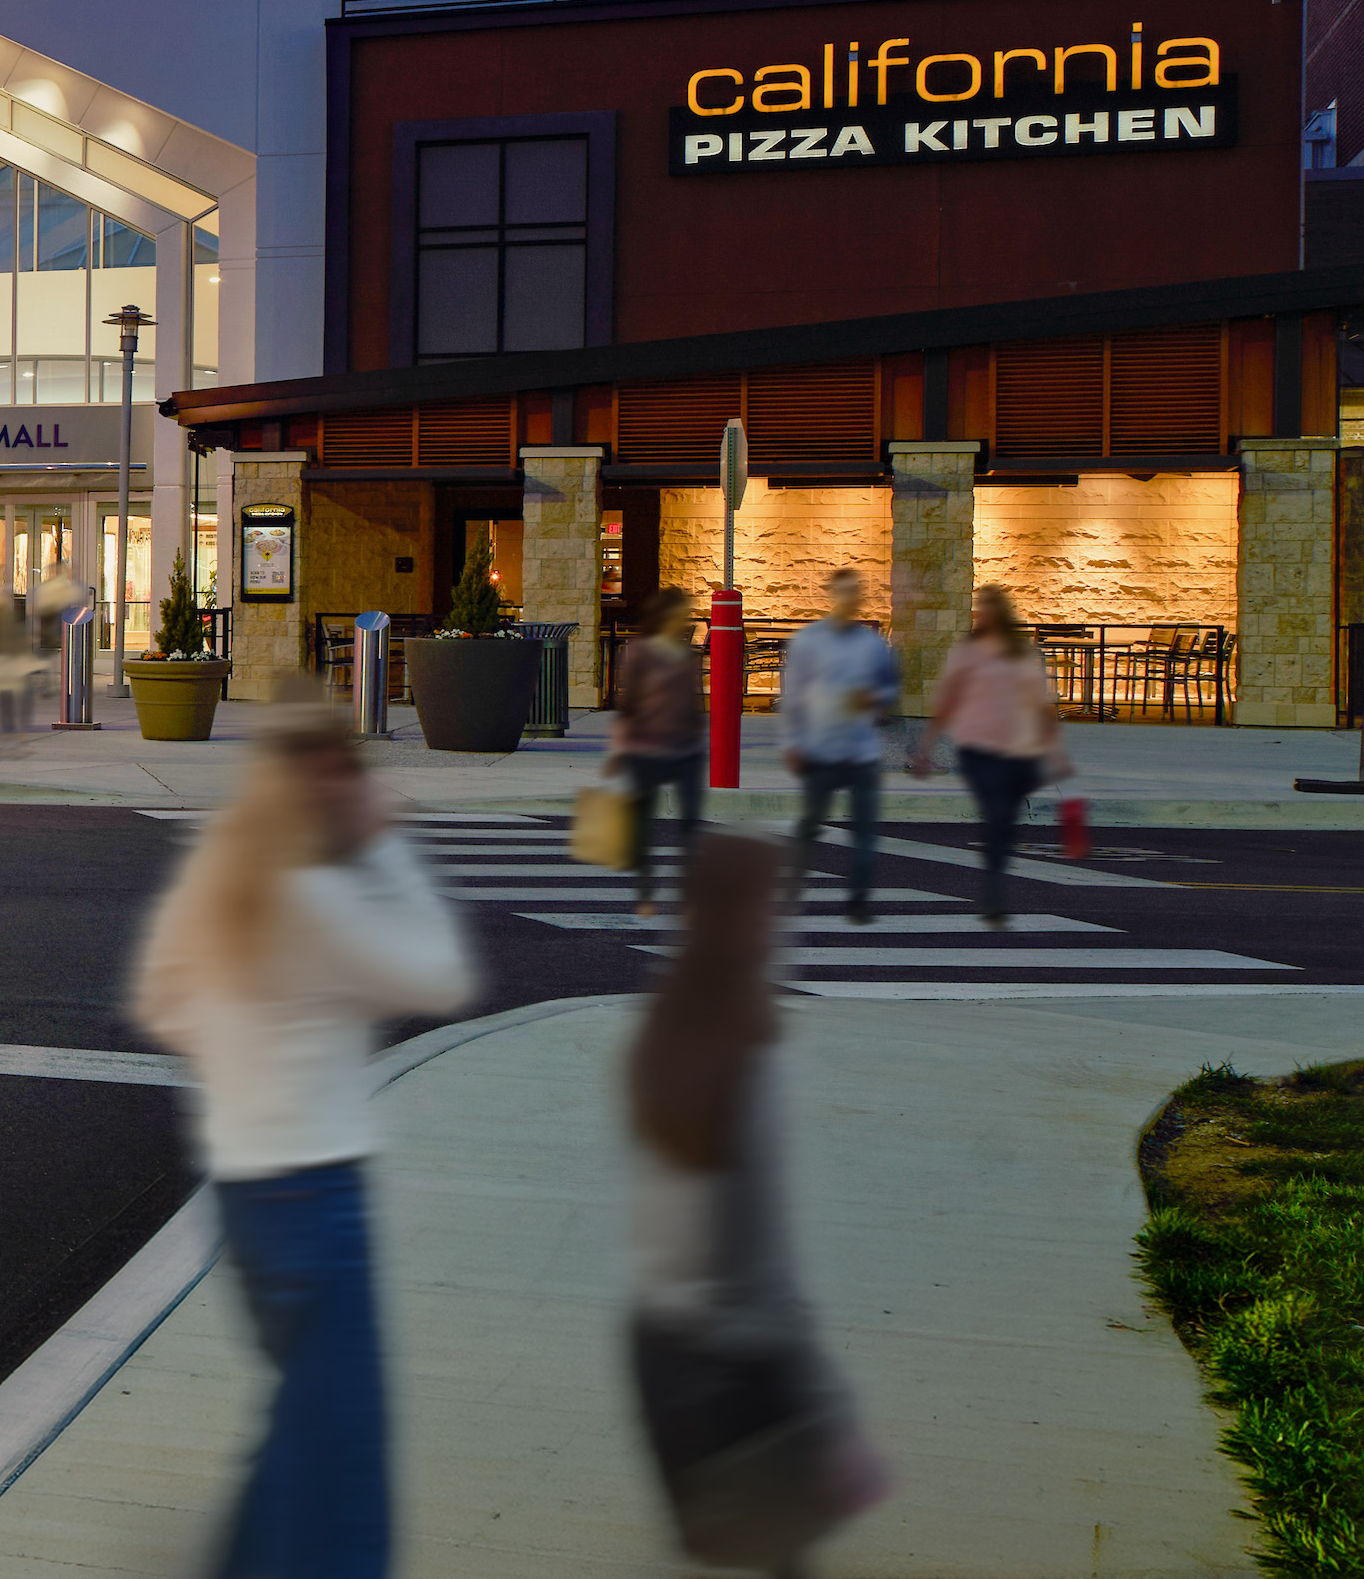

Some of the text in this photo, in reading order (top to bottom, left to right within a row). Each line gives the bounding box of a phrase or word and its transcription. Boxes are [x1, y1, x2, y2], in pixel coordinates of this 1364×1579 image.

[686, 21, 1221, 117] california
[684, 105, 1216, 165] PIZZA KITCHEN
